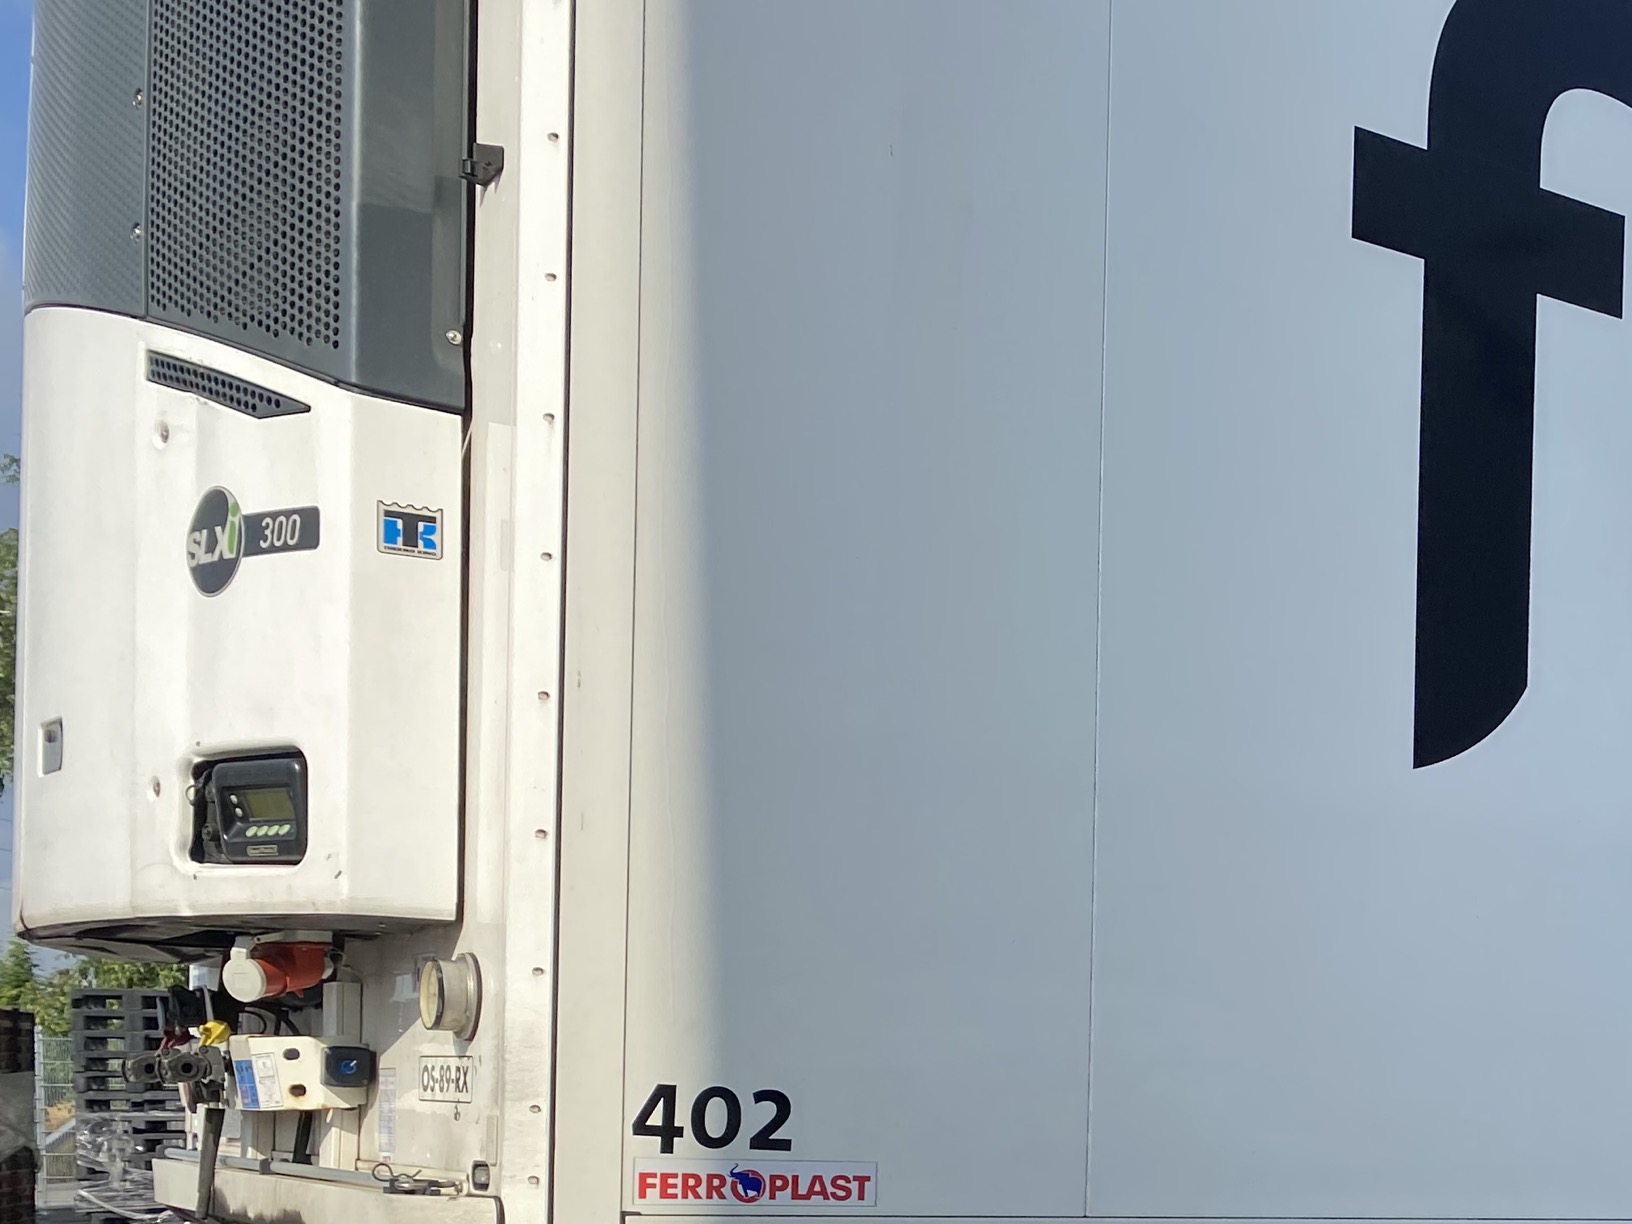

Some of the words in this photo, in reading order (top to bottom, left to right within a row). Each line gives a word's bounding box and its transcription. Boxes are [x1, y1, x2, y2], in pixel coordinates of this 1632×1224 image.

[260, 514, 301, 548] 300
[421, 1064, 470, 1094] OS-89-RX
[631, 1083, 793, 1154] 402
